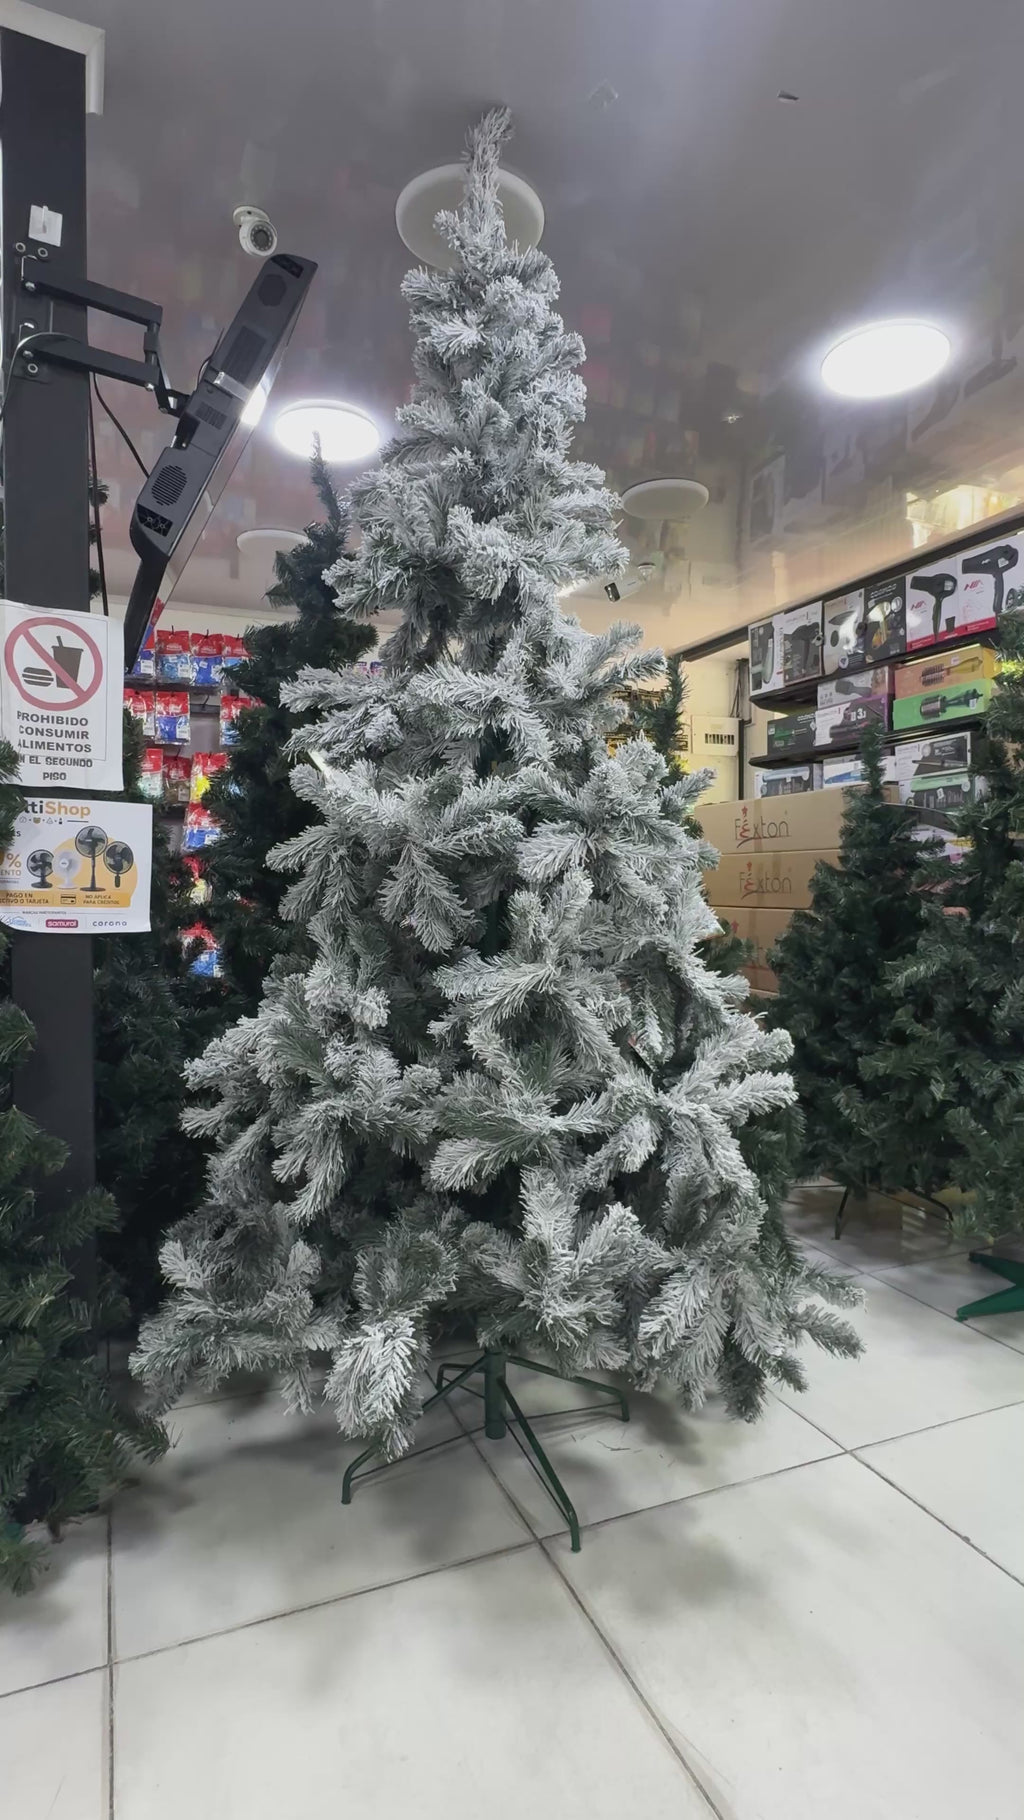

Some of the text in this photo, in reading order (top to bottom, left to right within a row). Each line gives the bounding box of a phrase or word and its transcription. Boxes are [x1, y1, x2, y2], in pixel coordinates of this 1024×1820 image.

[17, 711, 88, 726] PROHIBIDO
[19, 725, 89, 740] CONSUMIR
[18, 739, 92, 753] ALIMENTOS
[29, 755, 41, 765] EL
[43, 772, 67, 781] PISO
